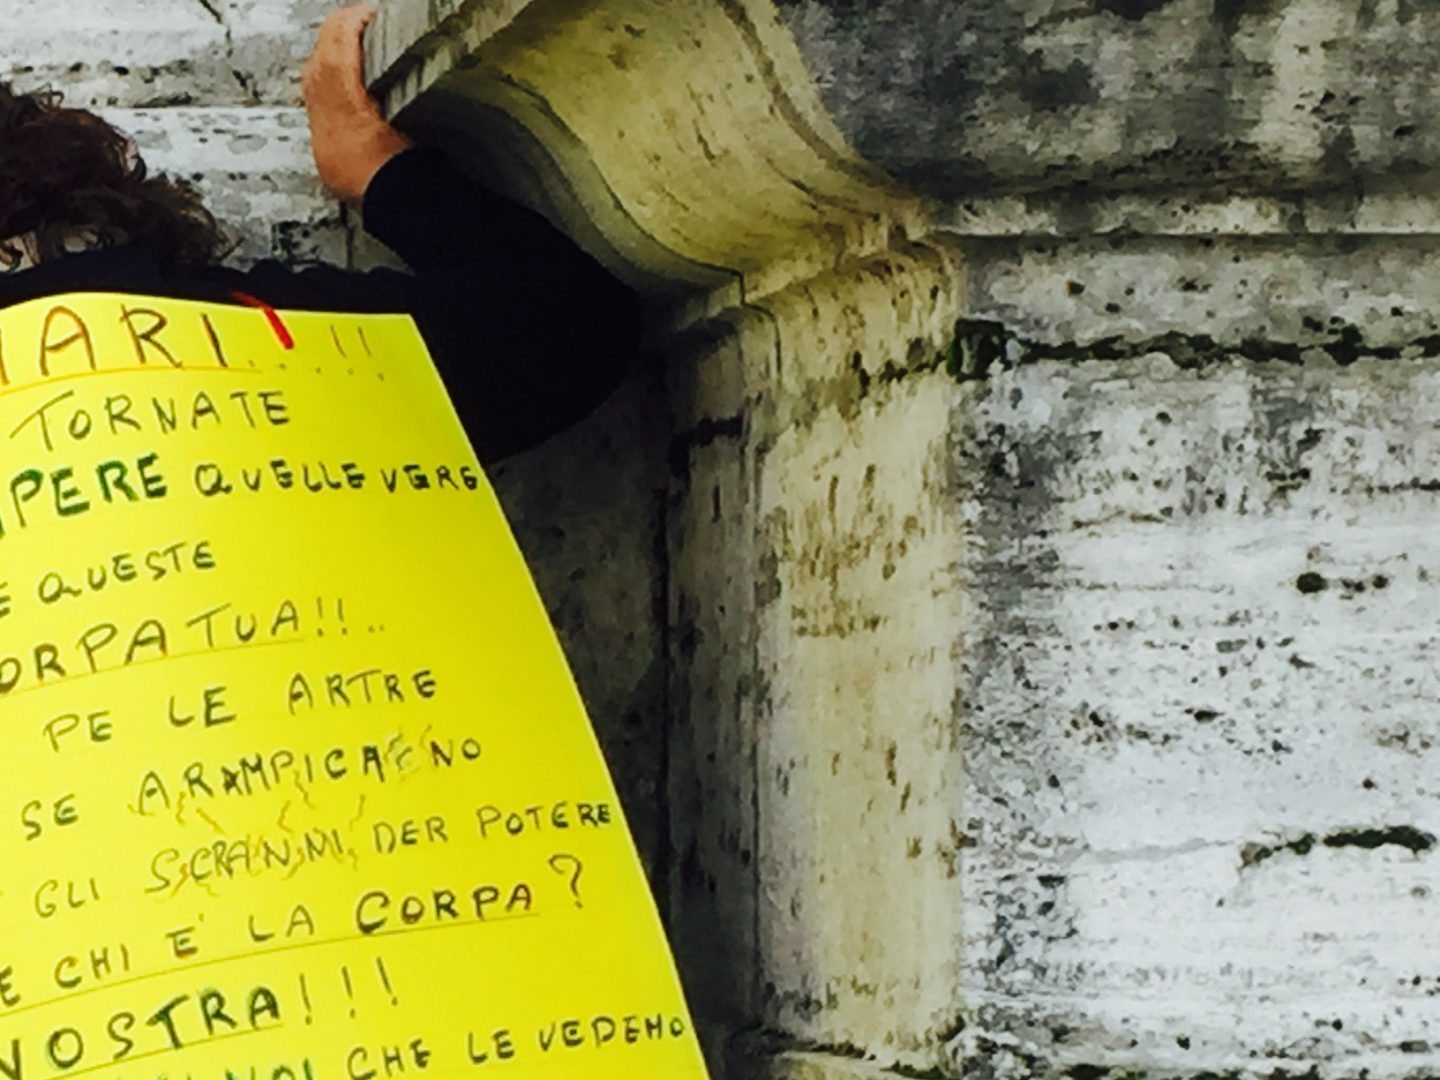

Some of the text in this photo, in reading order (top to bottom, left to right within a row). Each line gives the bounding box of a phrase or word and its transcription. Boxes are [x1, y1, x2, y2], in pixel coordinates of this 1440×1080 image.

[10, 390, 292, 454] TORNATE
[194, 460, 365, 497] QUELLE
[380, 464, 479, 494] VERE
[38, 540, 215, 602] QUESTE
[43, 711, 114, 755] PE
[168, 686, 235, 729] LE
[288, 667, 437, 715] ARTRE
[21, 796, 79, 842] SE
[34, 877, 101, 921] GLI
[374, 814, 448, 856] DER
[478, 802, 613, 840] POTERE
[54, 942, 130, 990] CHI
[248, 904, 315, 943] LA
[466, 1027, 515, 1066] LE
